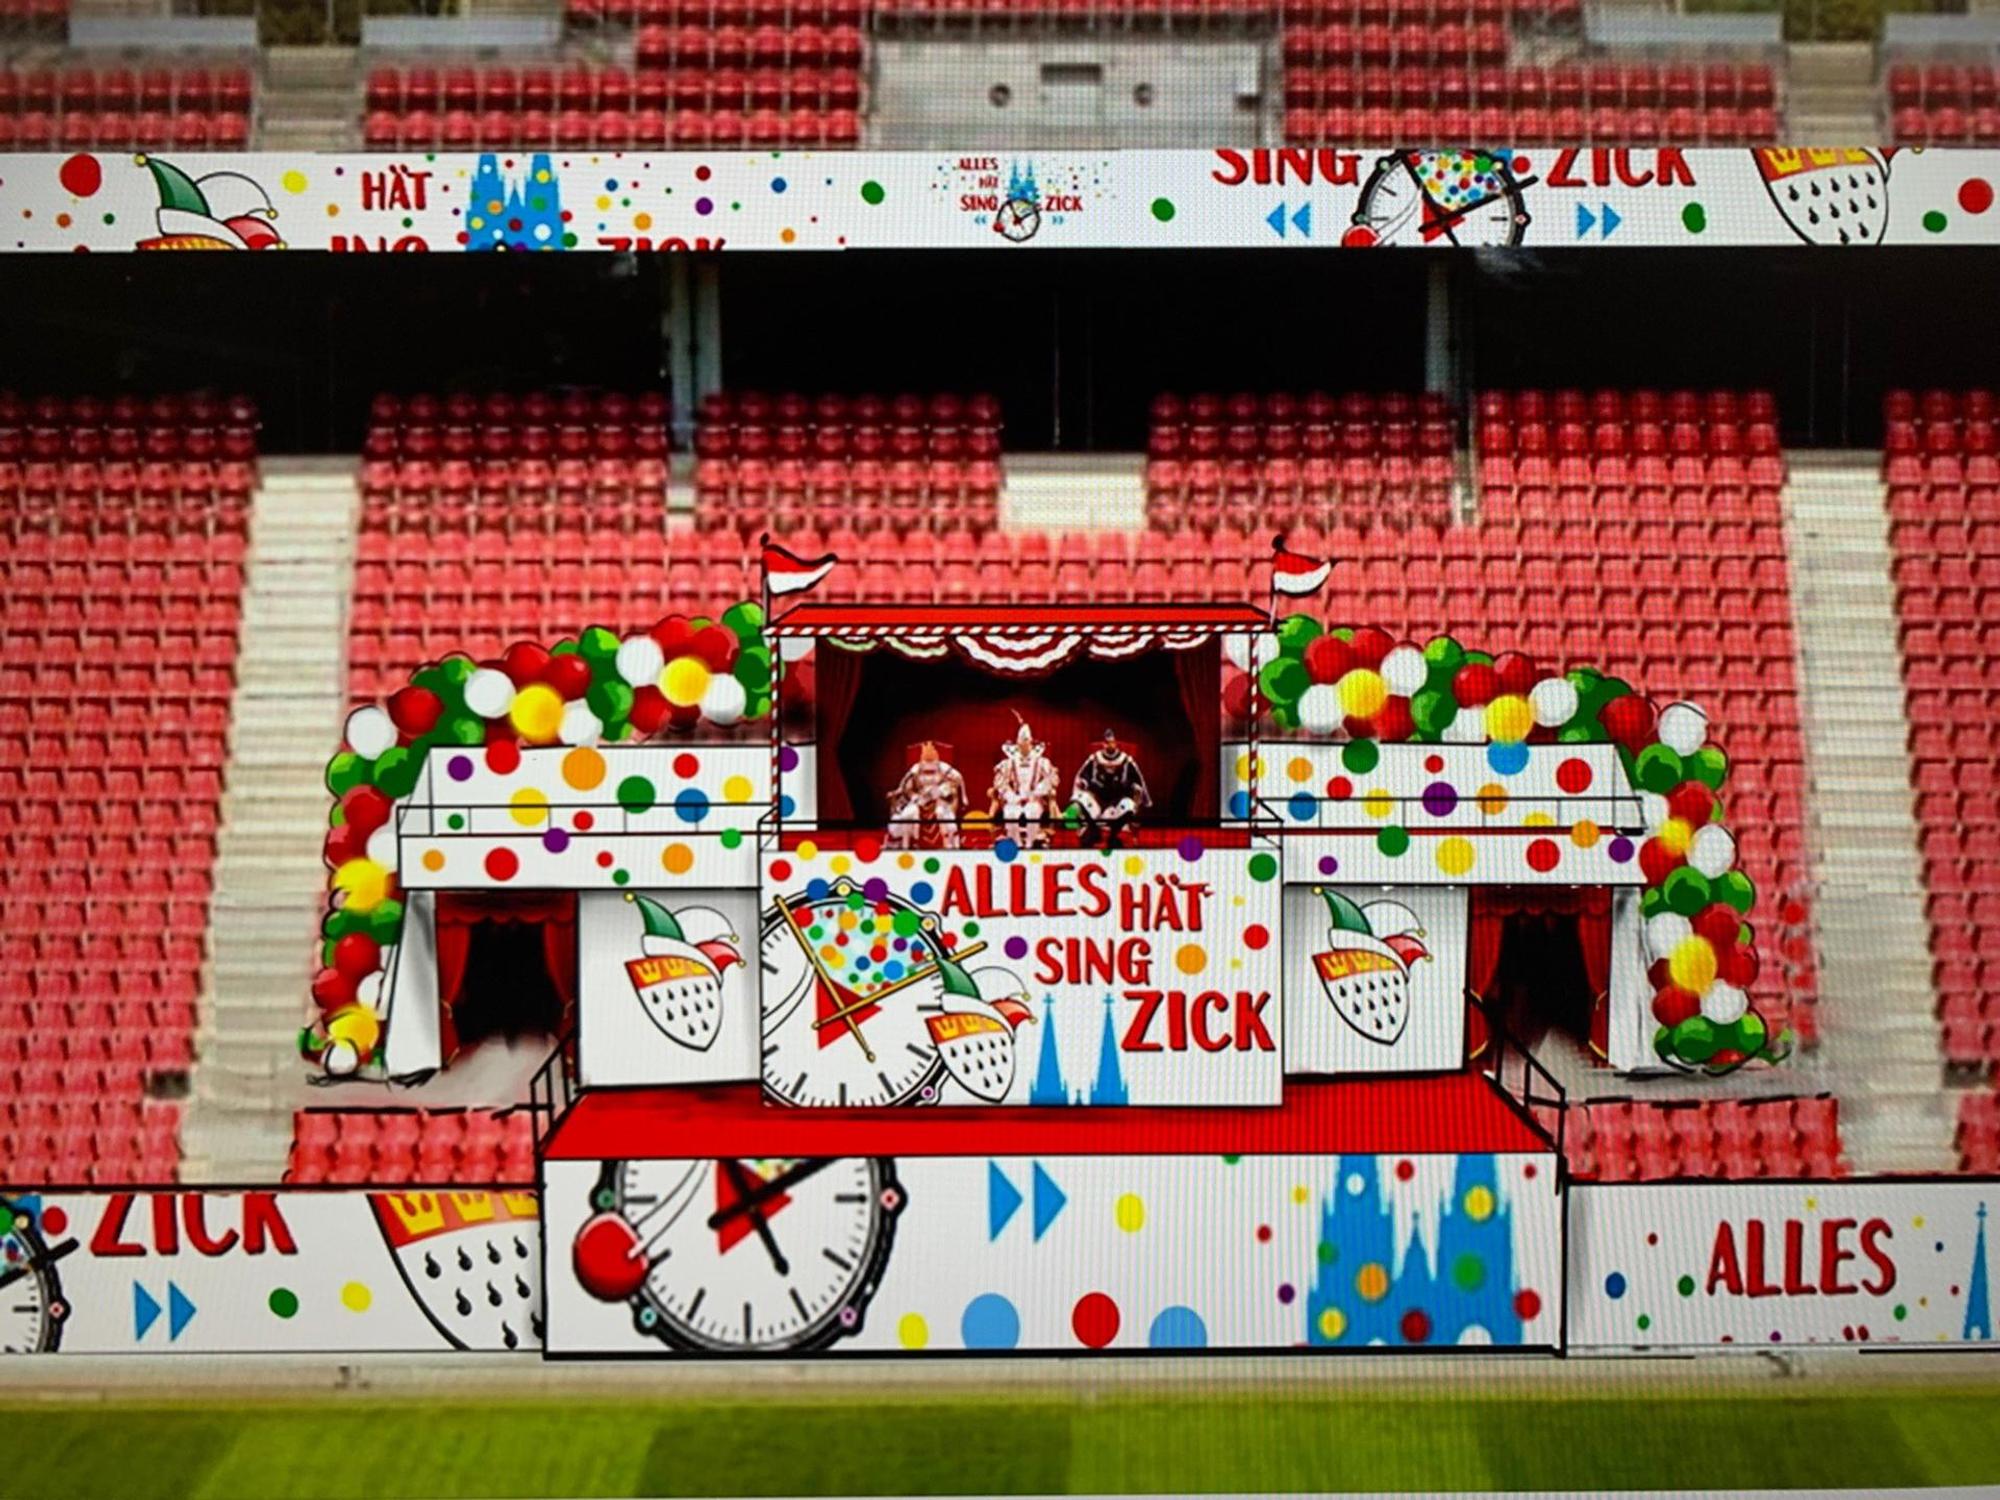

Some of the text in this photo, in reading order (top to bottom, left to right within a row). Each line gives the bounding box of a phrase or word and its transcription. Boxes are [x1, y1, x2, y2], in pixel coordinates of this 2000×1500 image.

[362, 164, 433, 211] HÄT
[959, 157, 999, 170] ALLES
[1546, 148, 1697, 187] ZICK
[960, 194, 1084, 212] SING ZICK
[941, 863, 1215, 932] ALLES HÄT
[1034, 937, 1153, 985] SING
[1120, 991, 1276, 1052] ZICK
[89, 1193, 298, 1256] ZICK
[1706, 1218, 1898, 1297] ALLES
